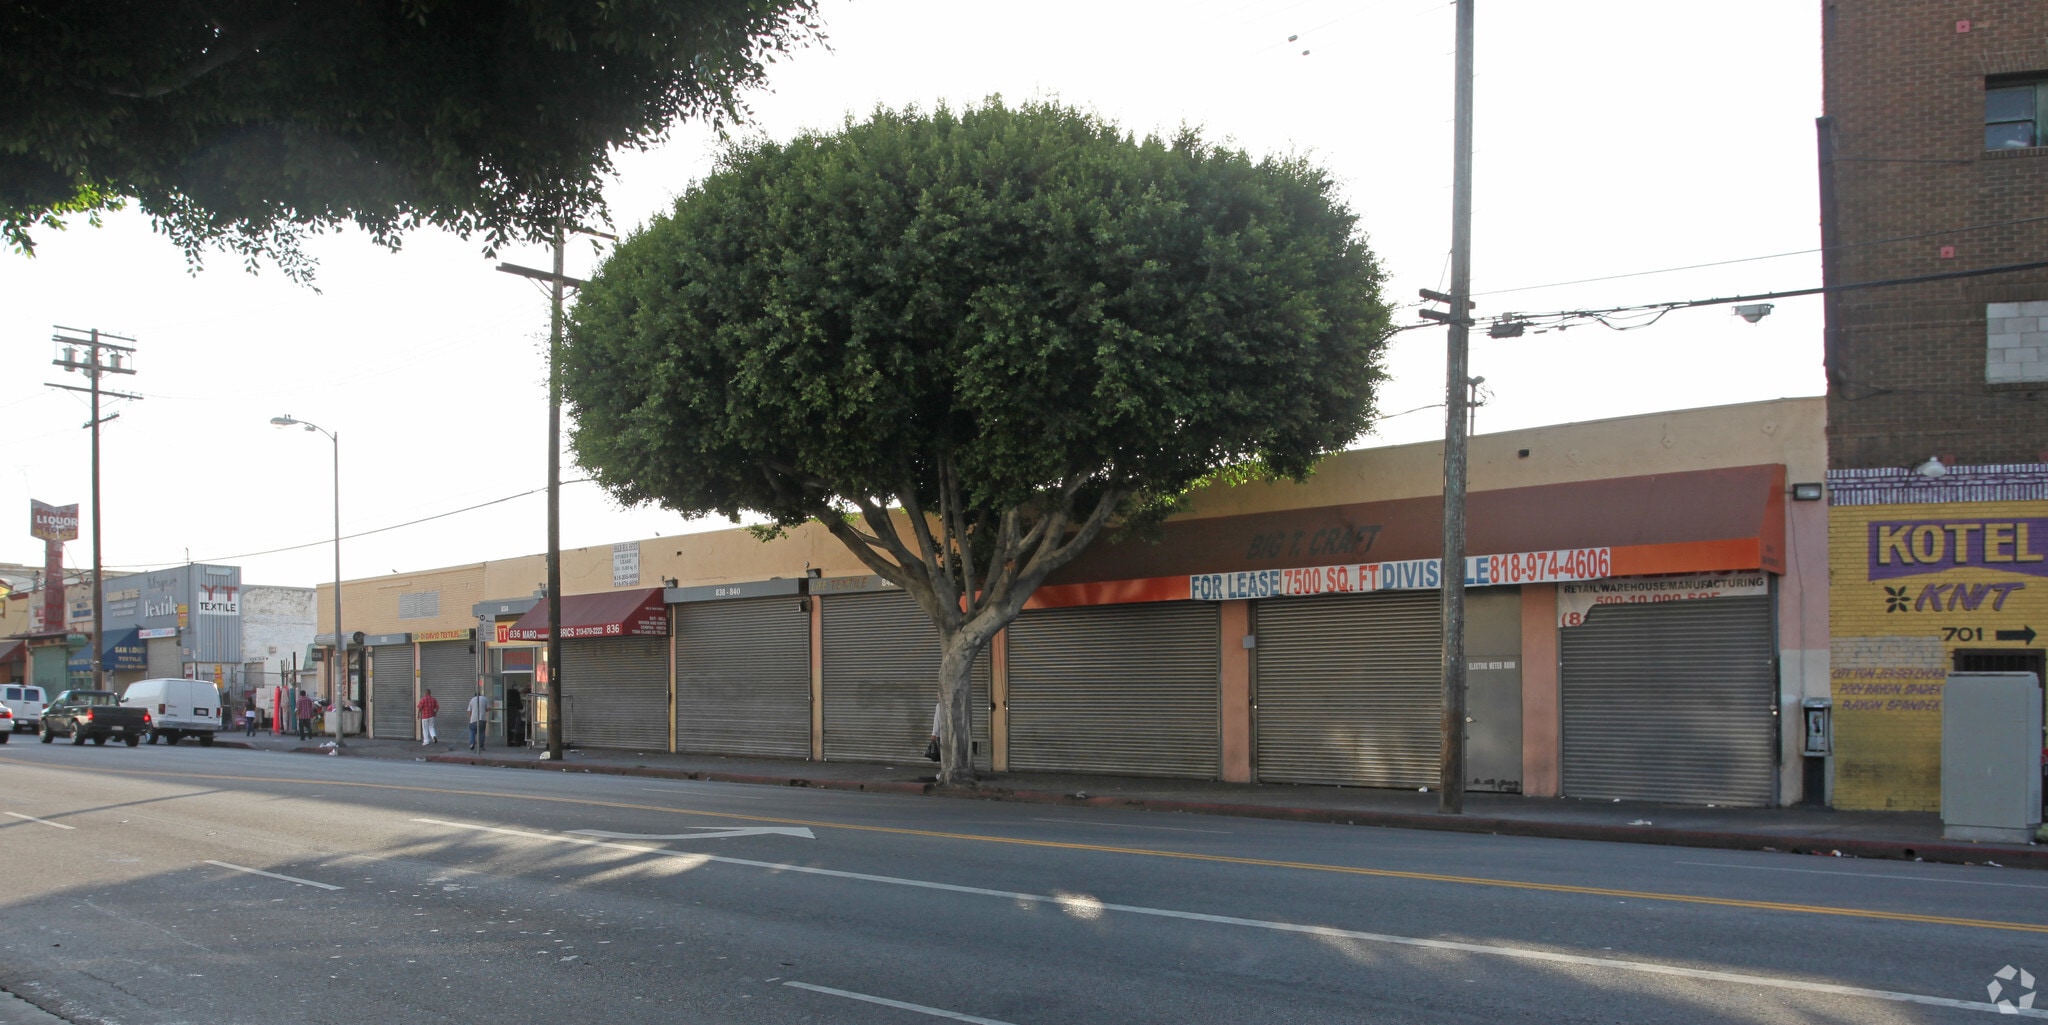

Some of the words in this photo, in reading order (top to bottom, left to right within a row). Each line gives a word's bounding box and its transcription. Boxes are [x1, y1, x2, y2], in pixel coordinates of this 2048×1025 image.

[36, 515, 78, 526] LIQUOR
[1247, 534, 1286, 560] BIG
[1308, 525, 1383, 557] CRAFT
[1877, 523, 2044, 566] KOTEL
[1191, 575, 1222, 600] FOR
[1228, 571, 1280, 598] LEASE
[1284, 568, 1321, 595] 7500
[1326, 566, 1353, 592] SQ.
[1359, 565, 1379, 591] FT
[1382, 557, 1489, 589] DIVISLE
[1490, 549, 1609, 584] 818-974-4606
[831, 578, 867, 590] TEXTILE
[1564, 577, 1764, 594] RETAIL/WAREHOUSE/MANUFACTURING
[715, 588, 725, 596] 838
[1915, 582, 2026, 612] KNIT
[200, 602, 236, 612] TEXTILE
[498, 628, 506, 640] YT
[606, 624, 619, 633] 836
[510, 630, 520, 638] 836
[522, 630, 536, 639] MARO
[1941, 627, 1983, 642] 701
[1469, 662, 1488, 670] ELECTRIC
[1504, 661, 1515, 669] ROOM
[1877, 668, 1913, 679] JERSEY
[1840, 684, 1864, 694] POLY
[1865, 683, 1900, 694] RAYON
[1842, 700, 1884, 710] RAYON
[1886, 700, 1939, 711] SPANDEX
